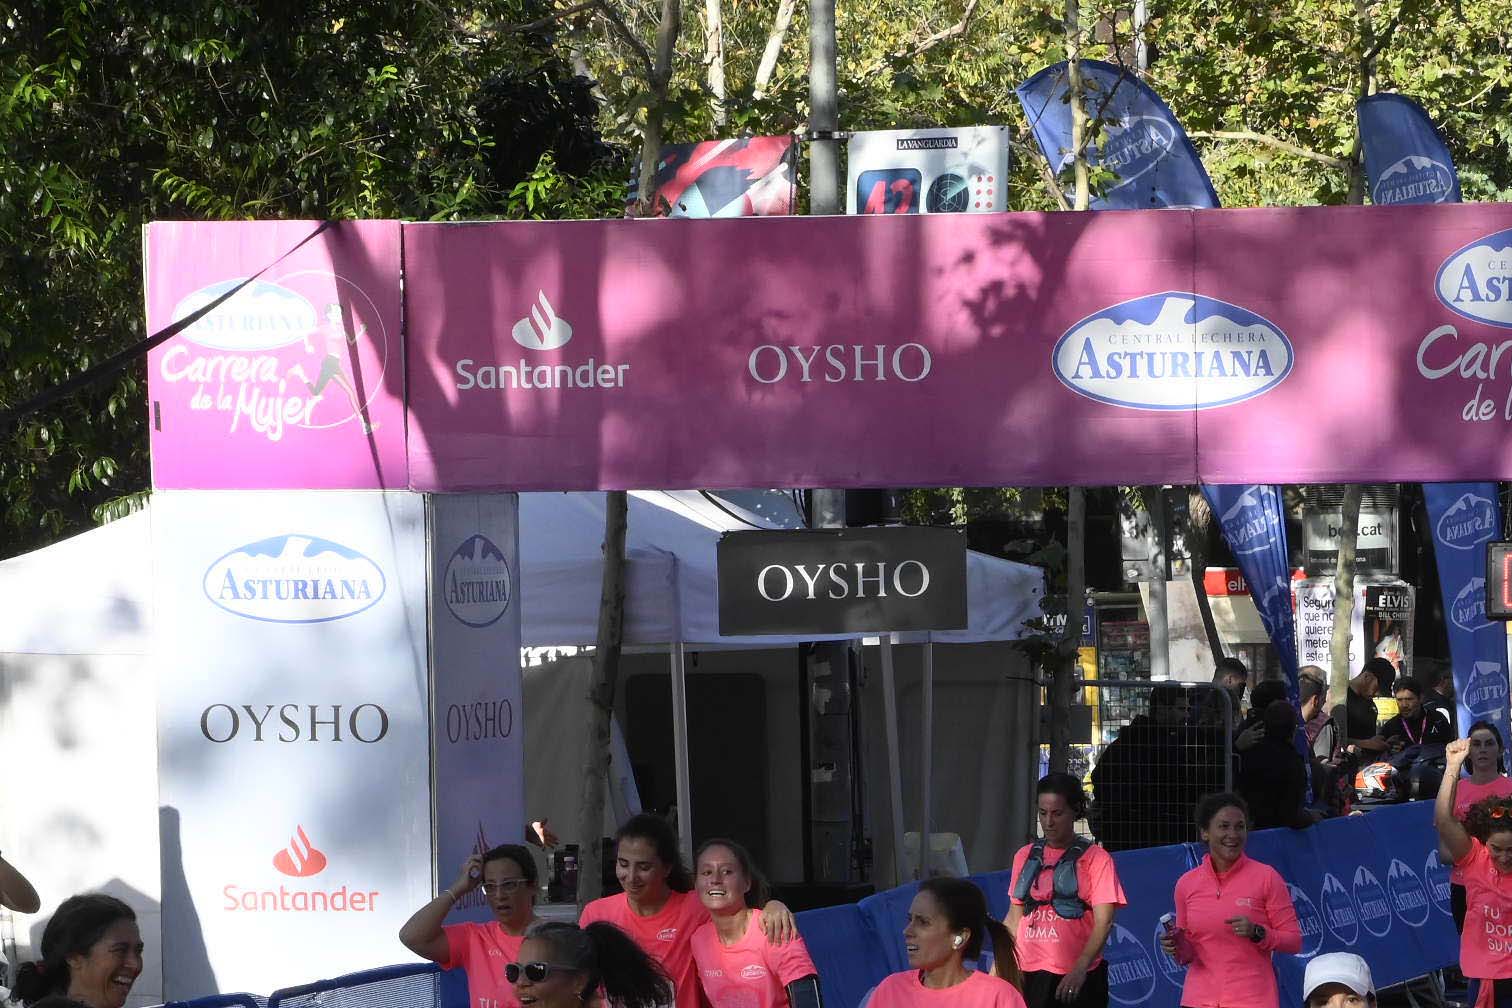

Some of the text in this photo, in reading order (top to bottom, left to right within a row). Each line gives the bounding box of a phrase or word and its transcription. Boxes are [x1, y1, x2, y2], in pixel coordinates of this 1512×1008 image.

[1107, 331, 1267, 346] CENTRAL LECHERA
[160, 343, 281, 384] Carrera
[456, 357, 630, 390] Santander
[748, 342, 933, 384] OYSHO
[1071, 336, 1275, 380] ASTURIANA
[189, 376, 324, 442] de la Mujer
[1461, 383, 1496, 422] de
[1328, 523, 1384, 538] b.cat
[218, 567, 373, 601] ASTURIANA
[449, 571, 507, 605] ASTURIANA
[757, 560, 931, 602] OYSHO
[1378, 595, 1410, 608] ELVIS
[1304, 612, 1321, 625] que
[1304, 623, 1335, 636] quiere
[1305, 638, 1328, 649] mete
[1305, 651, 1324, 662] este
[200, 703, 390, 744] OYSHO
[447, 698, 513, 744] OYSHO
[224, 885, 379, 913] Santander
[1483, 905, 1500, 919] TU
[1023, 926, 1059, 939] SUMA
